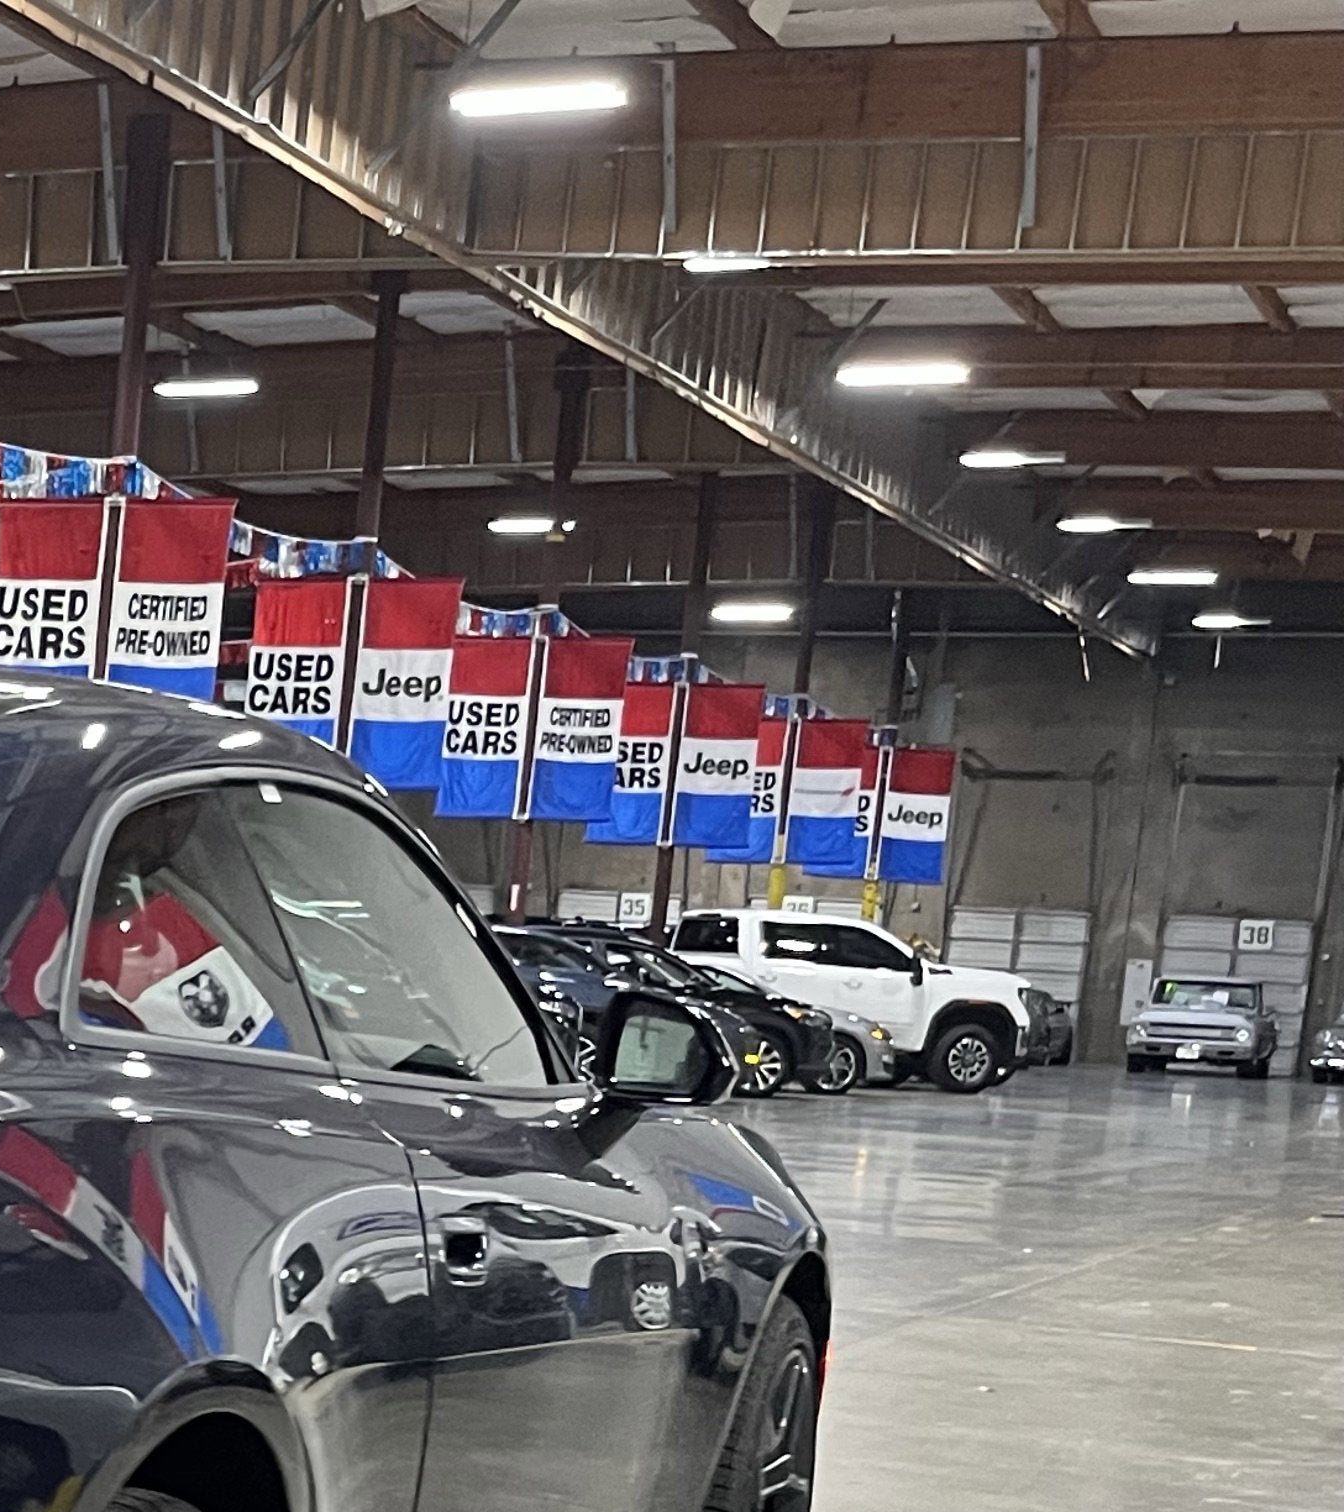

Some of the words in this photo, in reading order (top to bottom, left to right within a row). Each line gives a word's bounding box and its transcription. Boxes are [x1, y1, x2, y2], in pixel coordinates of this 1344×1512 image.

[128, 593, 208, 622] CERTIFIED
[115, 627, 211, 657] PRE-OWNED
[253, 652, 335, 682] USED
[362, 668, 442, 702] Jeep
[249, 684, 331, 714] CARS
[449, 700, 520, 727] USED
[550, 706, 611, 728] CERTIFIED
[446, 728, 518, 755] CARS
[540, 732, 613, 754] PRE-OWNED
[617, 742, 664, 764] SED
[615, 767, 661, 788] ARS
[684, 752, 750, 779] Jeep
[888, 805, 943, 828] Jeep
[623, 899, 646, 916] 35
[1243, 926, 1269, 944] 38
